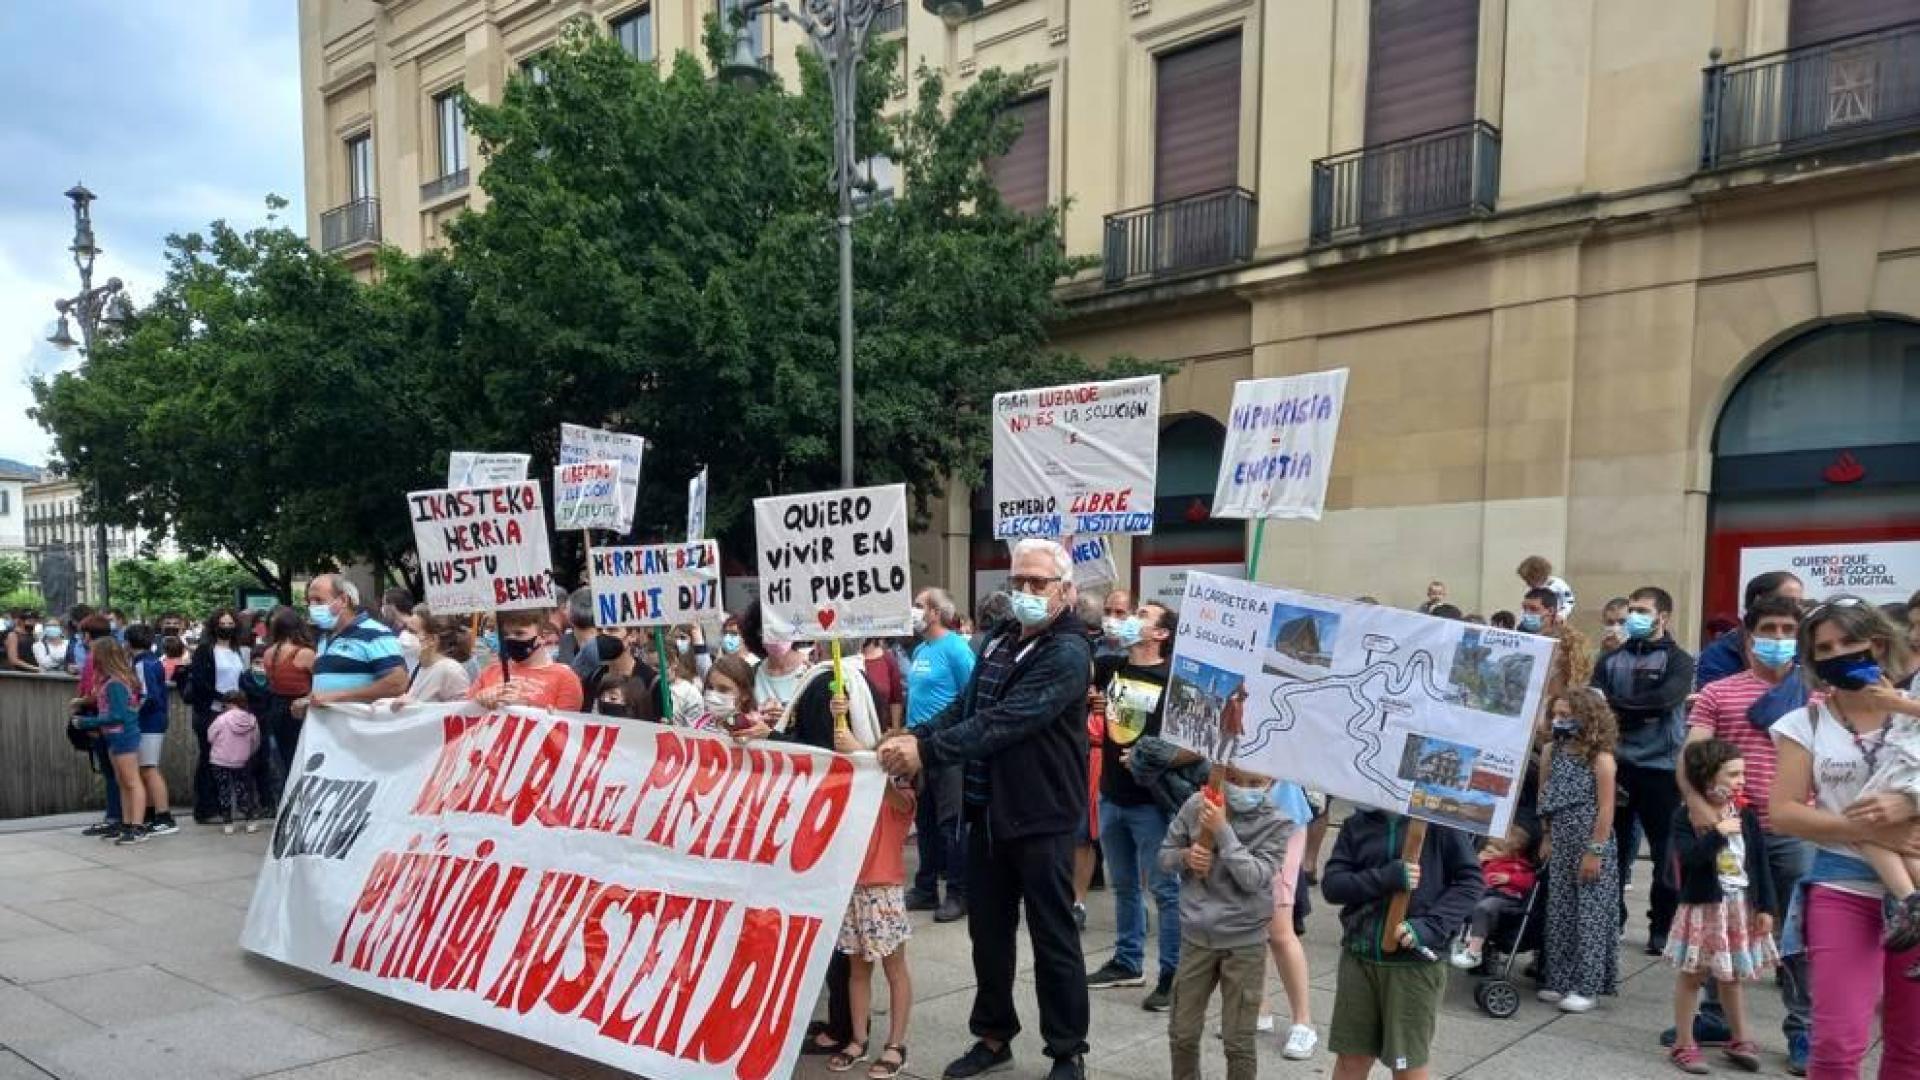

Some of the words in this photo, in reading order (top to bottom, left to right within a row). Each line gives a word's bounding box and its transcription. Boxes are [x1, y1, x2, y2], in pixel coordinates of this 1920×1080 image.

[1010, 414, 1030, 432] NO
[1037, 410, 1054, 426] ES
[1064, 408, 1079, 423] LA
[411, 486, 534, 522] IKASTEKO
[853, 527, 893, 556] EN
[427, 554, 497, 586] HUSTU
[593, 548, 669, 577] HERRIAN
[1792, 556, 1838, 566] QUIERO
[1842, 554, 1869, 566] QUE
[1811, 567, 1826, 577] MI
[1829, 564, 1886, 576] NEGOCIO
[811, 565, 905, 603] PUEBLO
[1823, 576, 1845, 587] SEA
[1848, 574, 1897, 586] DIGITAL
[599, 587, 662, 624] NAHI
[678, 579, 717, 611] DUT
[410, 714, 621, 830] DESALOJA
[600, 785, 628, 832] EL
[616, 730, 855, 874] PIRINEO
[484, 870, 734, 1058] HUSTEN
[678, 906, 823, 1080] DU
